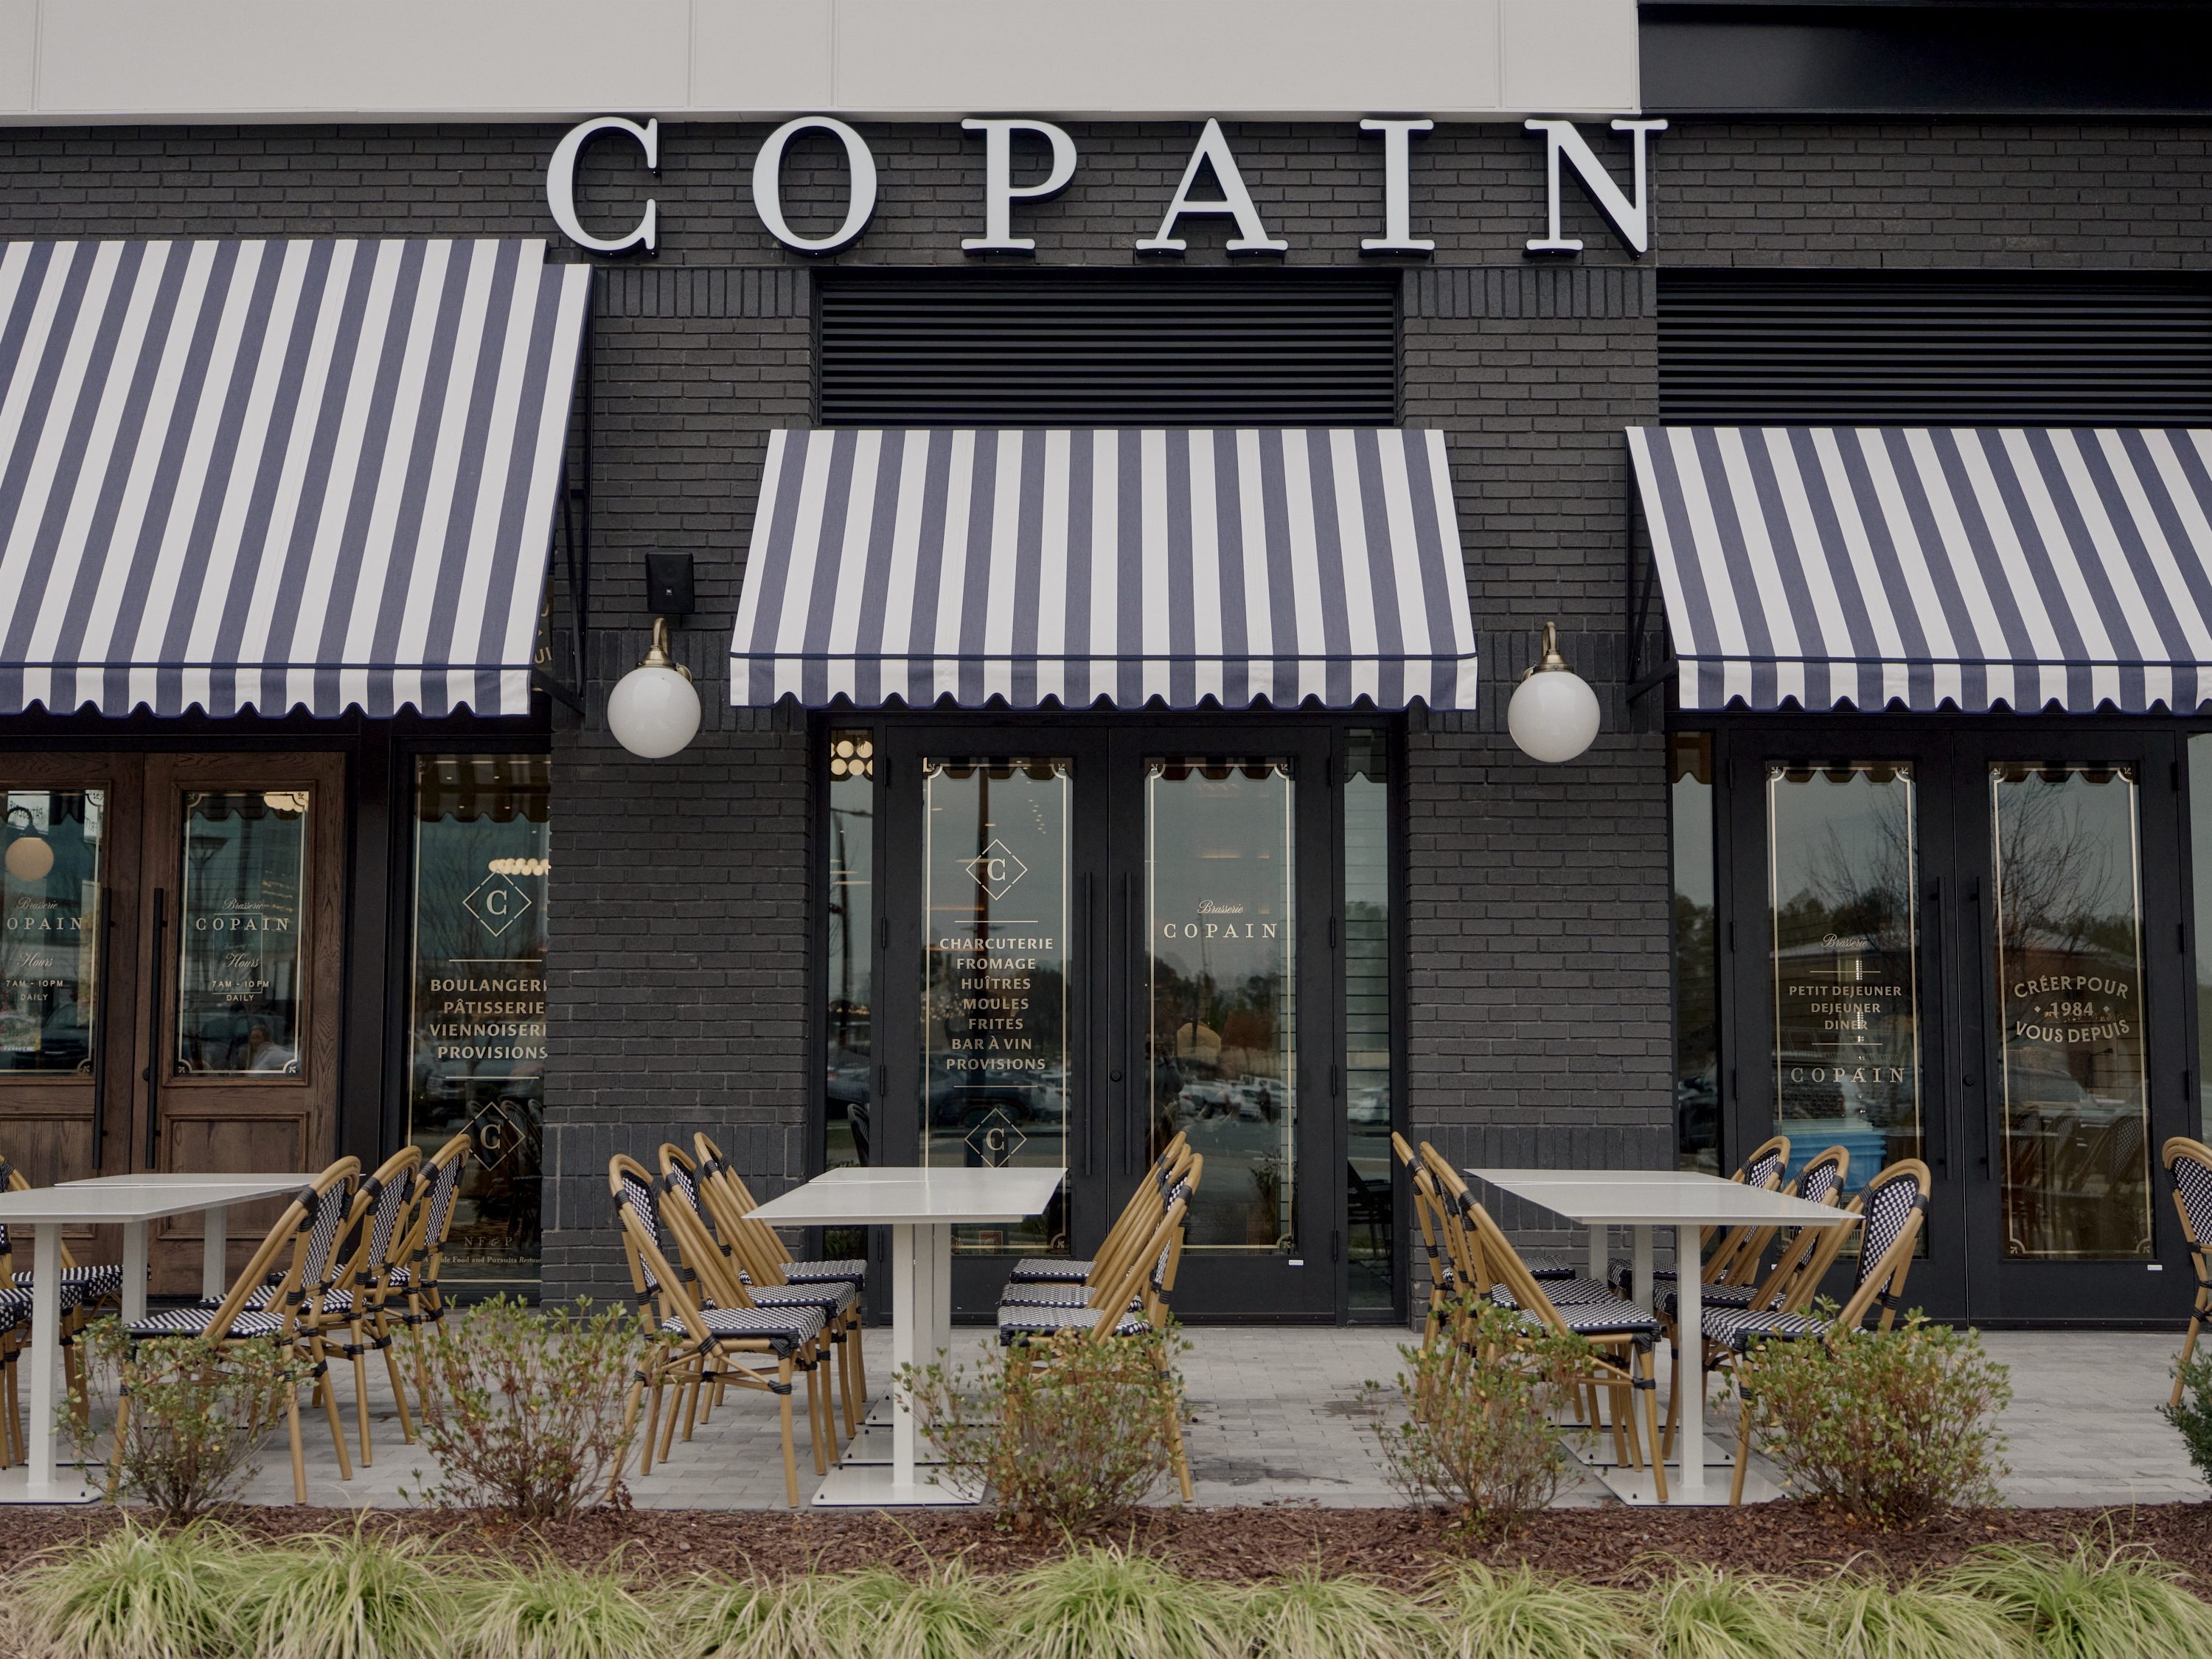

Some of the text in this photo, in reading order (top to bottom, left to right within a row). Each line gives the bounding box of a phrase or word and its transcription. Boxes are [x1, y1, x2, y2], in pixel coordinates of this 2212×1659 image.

[545, 115, 1669, 256] COPAIN
[987, 858, 1006, 881] C
[16, 897, 58, 909] Brasserie
[223, 897, 263, 910] Brasserie
[486, 889, 507, 915] C
[1197, 900, 1244, 914] Brasserie
[7, 917, 83, 930] OPAIN
[195, 918, 289, 931] COPAIN
[1164, 923, 1277, 939] COPAIN
[939, 938, 1053, 950] CHARCUTERIE
[1820, 933, 1868, 947] Brasserie
[17, 952, 53, 967] Hours
[223, 952, 259, 968] Hours
[956, 958, 1036, 970] FROMAGE
[431, 978, 547, 992] BOULANGERI
[961, 975, 1031, 990] HUÎTRES
[2014, 975, 2129, 999] CRÉER POUR
[1789, 986, 1902, 998] PETIT DEJEUNER
[444, 998, 545, 1015] PÂTISSERIE
[963, 998, 1029, 1009] MOULES
[1811, 1003, 1880, 1015] DEJEUNER
[2050, 1001, 2094, 1016] 1984
[429, 1023, 546, 1037] VIENNOISERI
[969, 1018, 1023, 1029] FRITES
[1824, 1020, 1868, 1030] DINER
[2017, 1019, 2129, 1043] VOUS DEPUIS
[952, 1035, 1032, 1050] BAR À VIN
[437, 1046, 549, 1060] PROVISIONS
[946, 1058, 1046, 1070] PROVISIONS
[1790, 1067, 1905, 1083] COPAIN
[480, 1124, 501, 1150] C
[986, 1127, 1005, 1151] C
